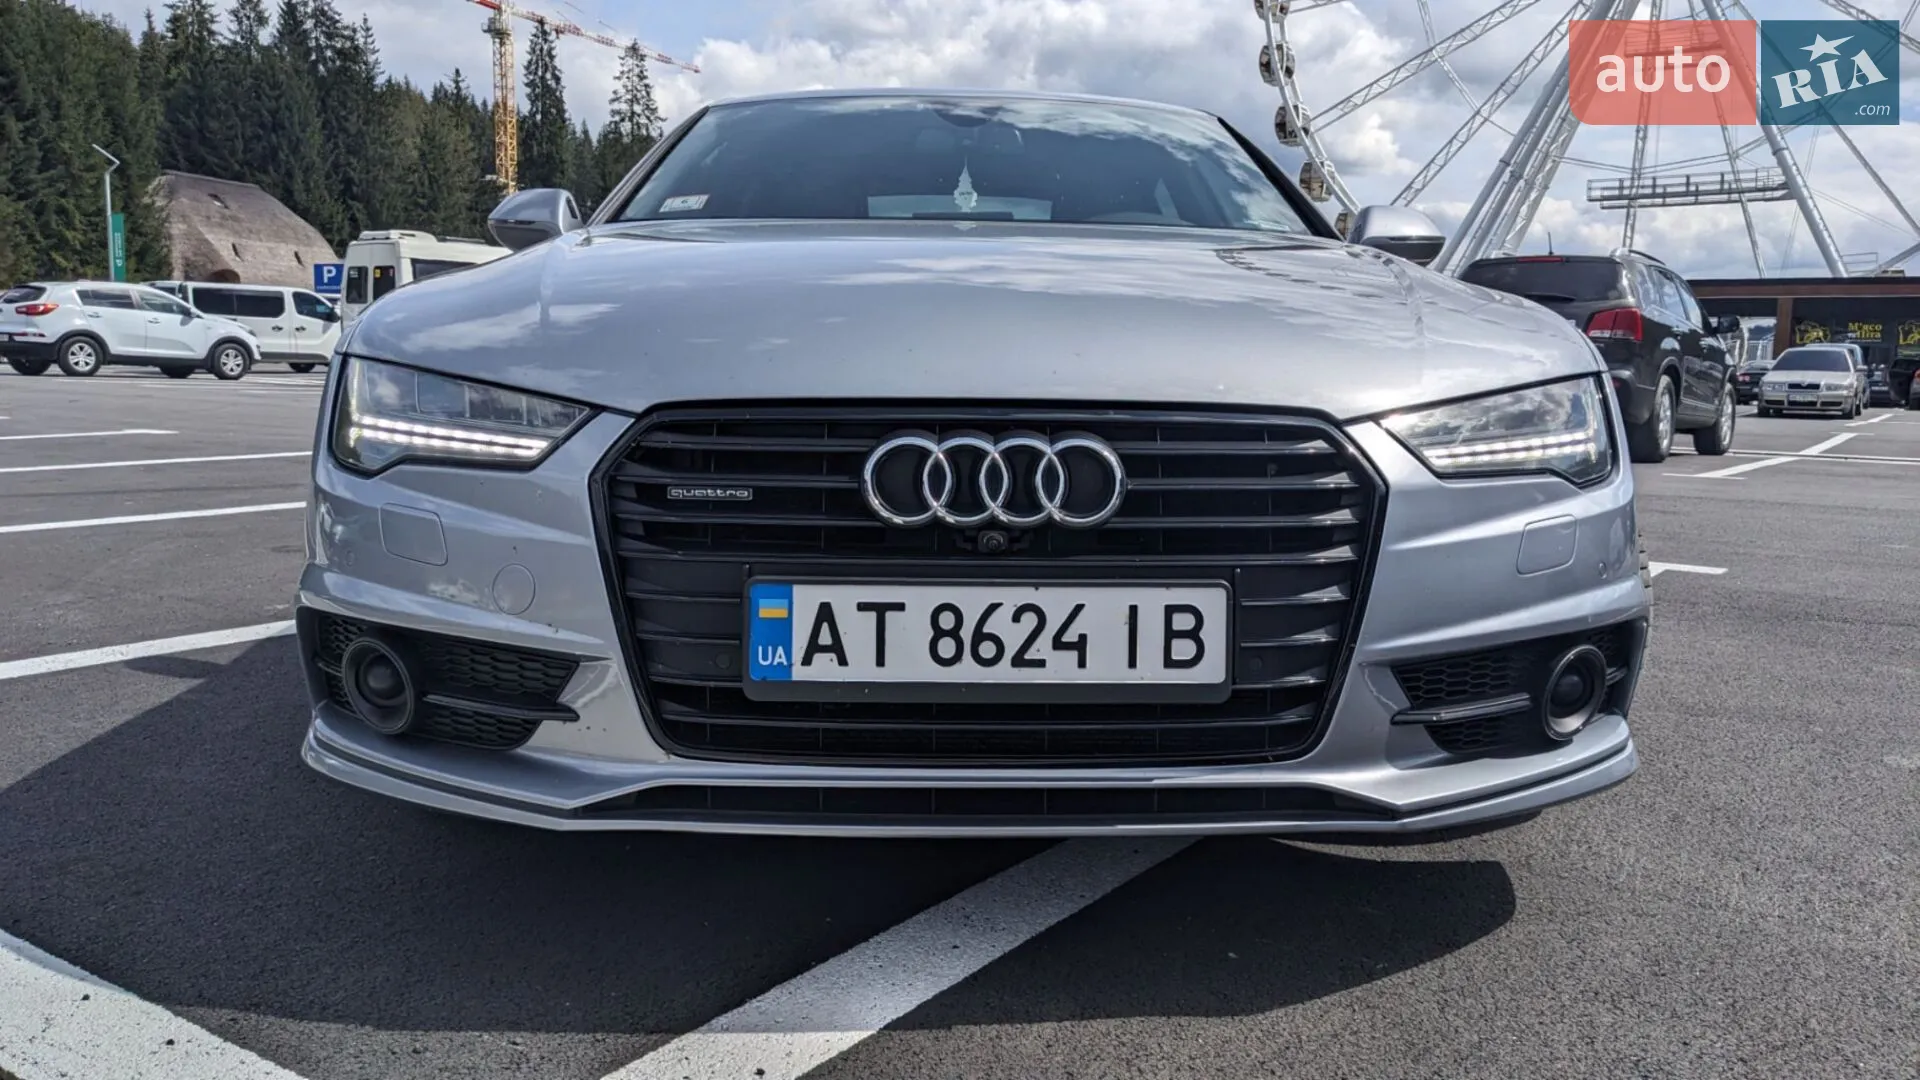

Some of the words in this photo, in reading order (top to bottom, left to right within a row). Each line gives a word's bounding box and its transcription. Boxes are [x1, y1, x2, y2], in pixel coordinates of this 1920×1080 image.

[323, 266, 337, 283] P
[670, 488, 749, 498] quattro
[800, 602, 906, 667] AT
[928, 602, 1088, 669] 8624
[1126, 603, 1206, 670] IB
[757, 645, 788, 666] UA
